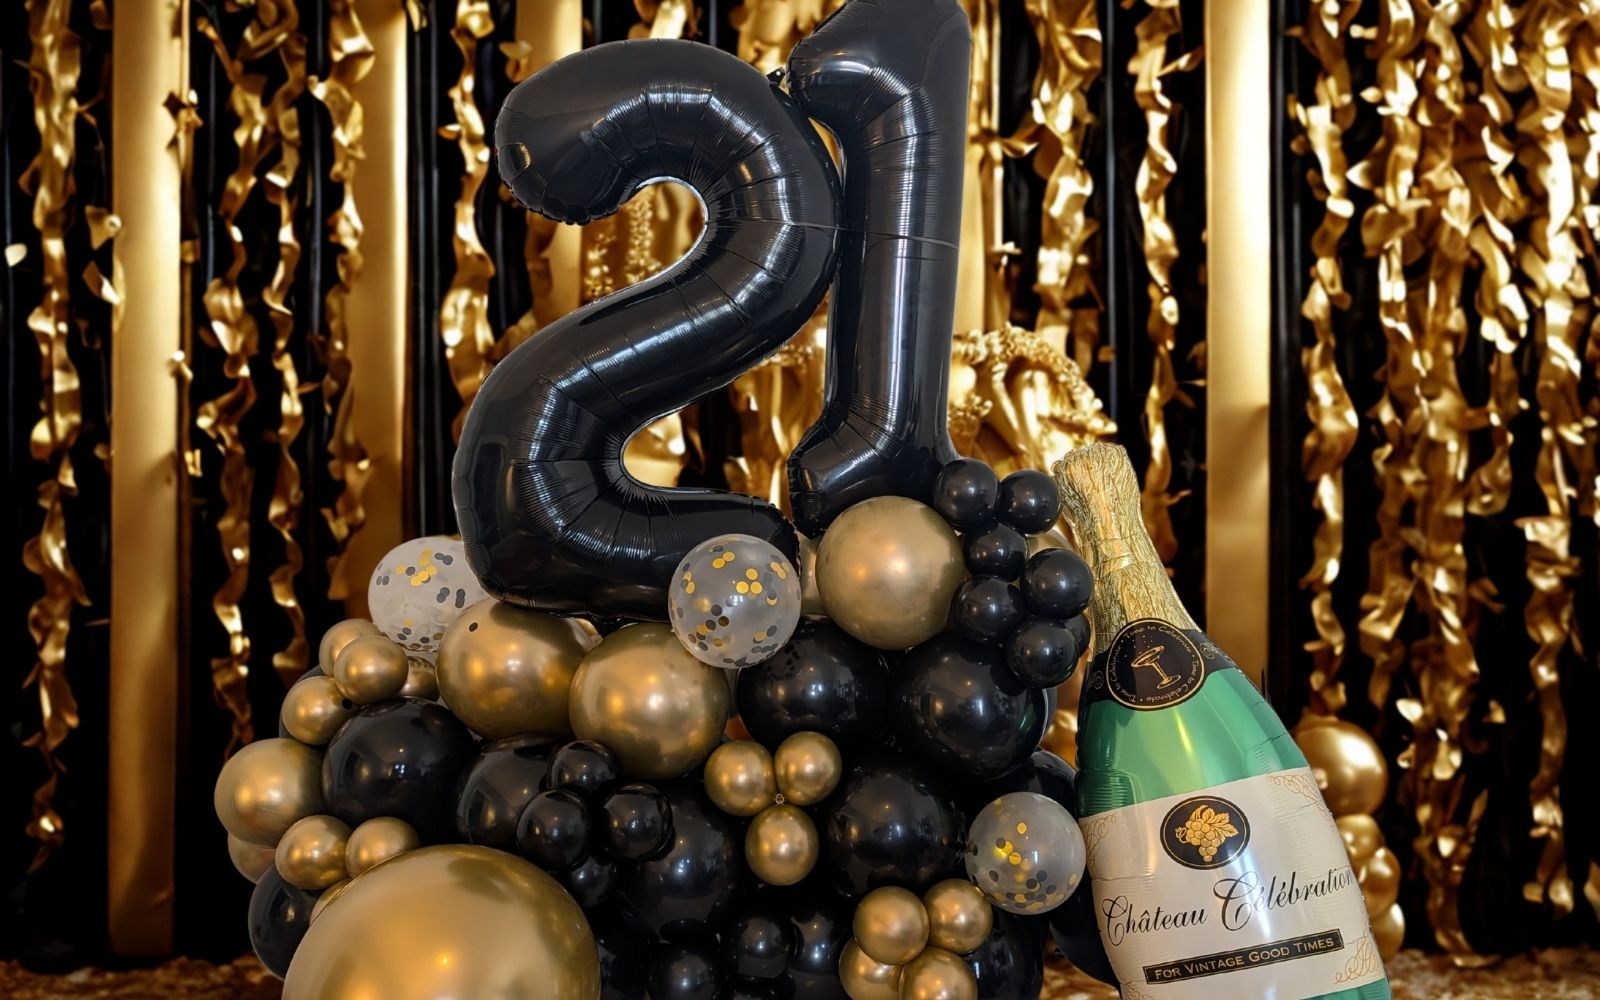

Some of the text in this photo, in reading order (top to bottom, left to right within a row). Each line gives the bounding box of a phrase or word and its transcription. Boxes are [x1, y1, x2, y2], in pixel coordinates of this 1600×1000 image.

[1124, 628, 1146, 639] Time
[1102, 895, 1208, 947] Château
[1154, 936, 1335, 981] FOR VINTAGE GOOD TIMES
